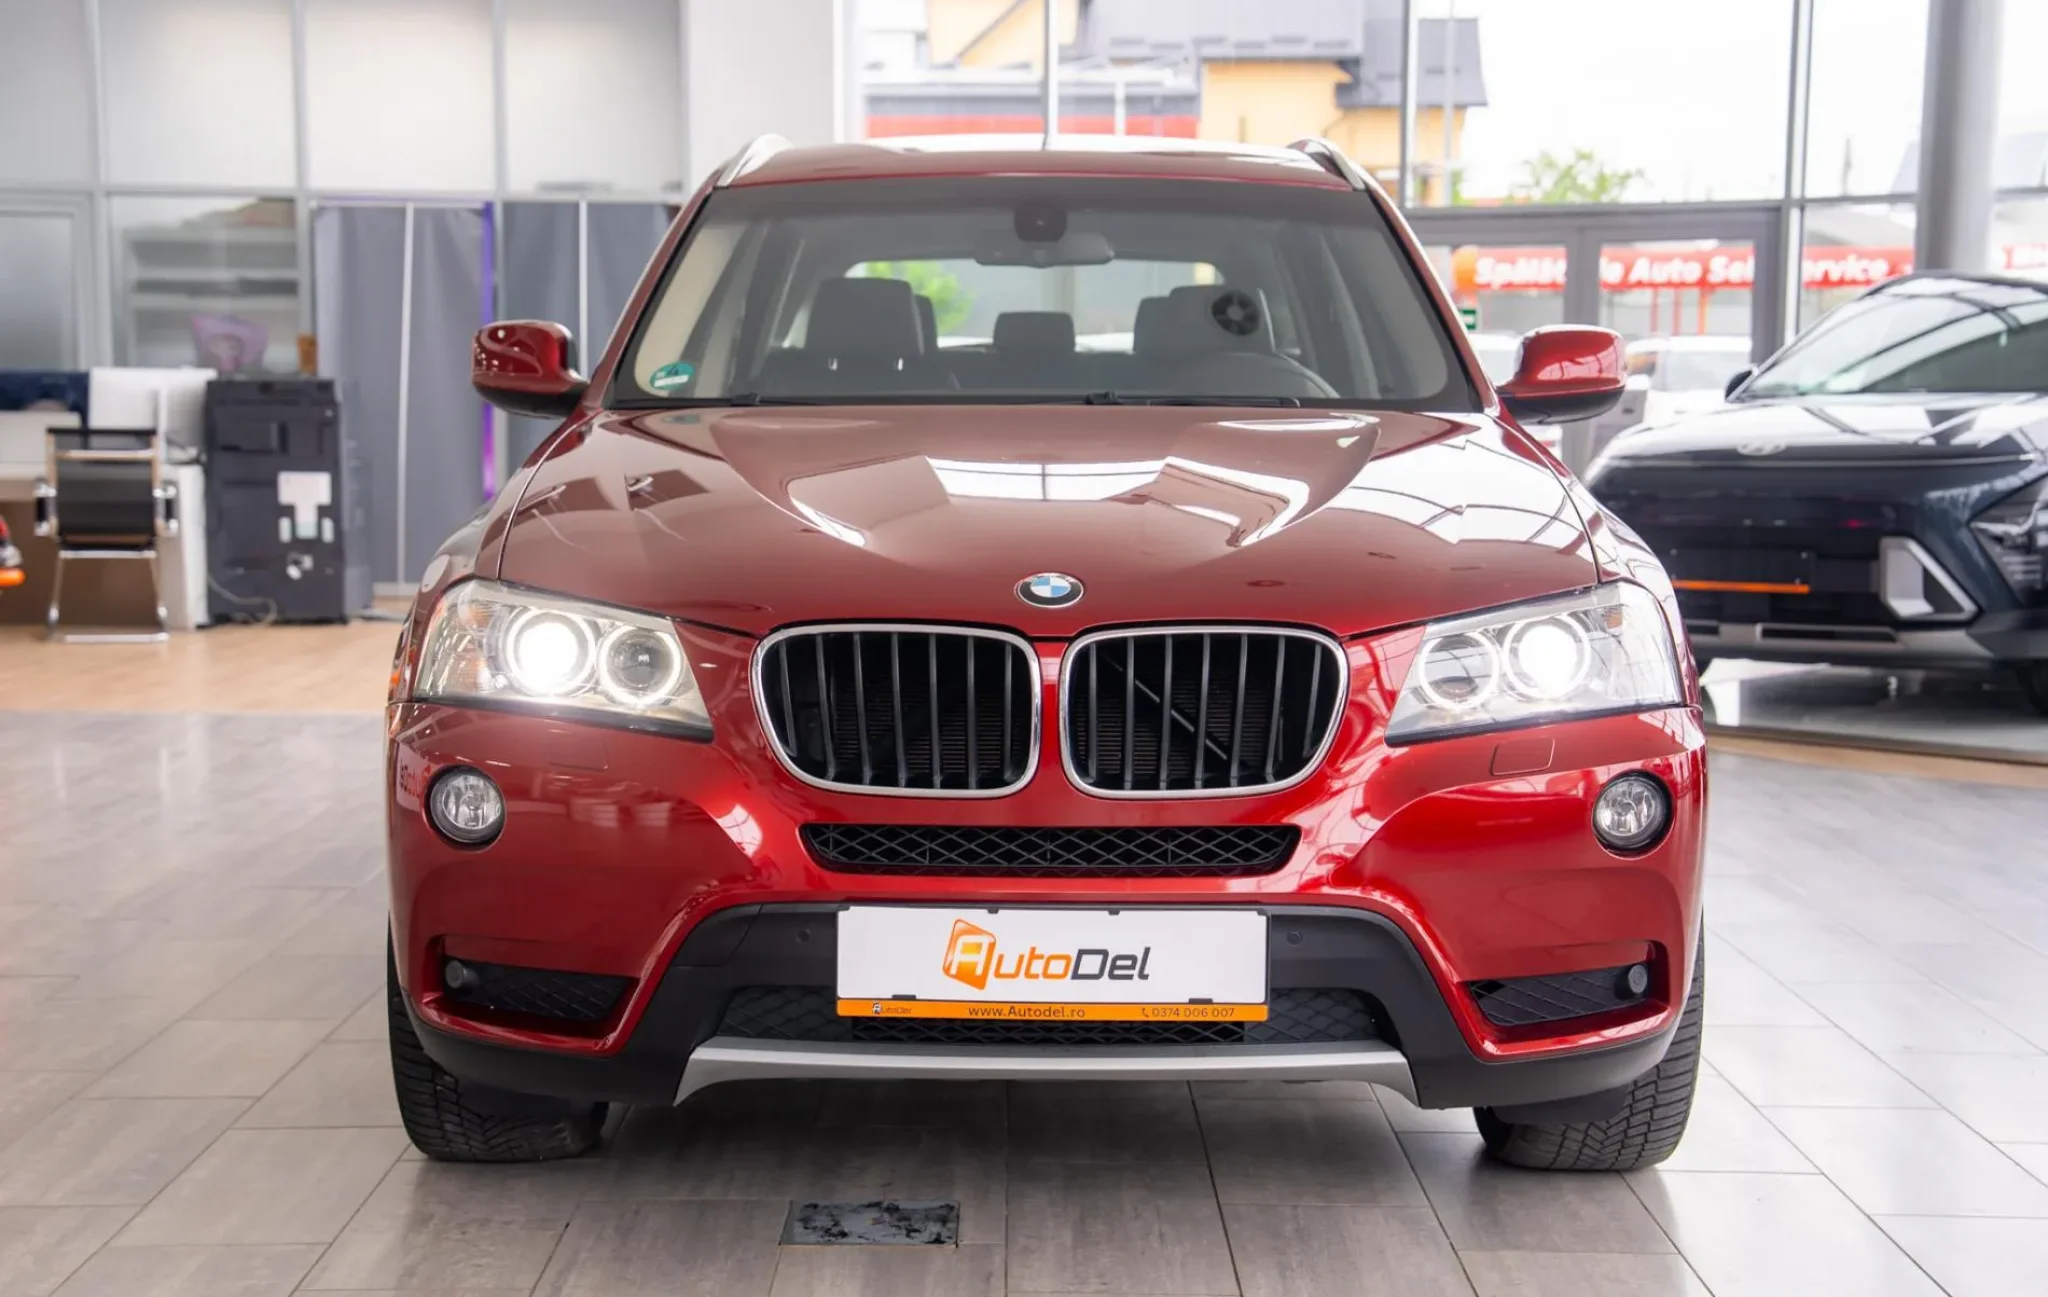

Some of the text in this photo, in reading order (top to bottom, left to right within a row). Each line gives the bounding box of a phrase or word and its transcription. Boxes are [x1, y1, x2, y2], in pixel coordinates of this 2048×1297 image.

[1628, 256, 1702, 282] Auto
[1707, 255, 1755, 282] Sel
[1802, 256, 1889, 281] ervice
[946, 927, 1151, 984] AutoDel
[968, 1005, 1086, 1019] www.Autodel.ro
[1152, 1007, 1235, 1018] 0374 006 007
